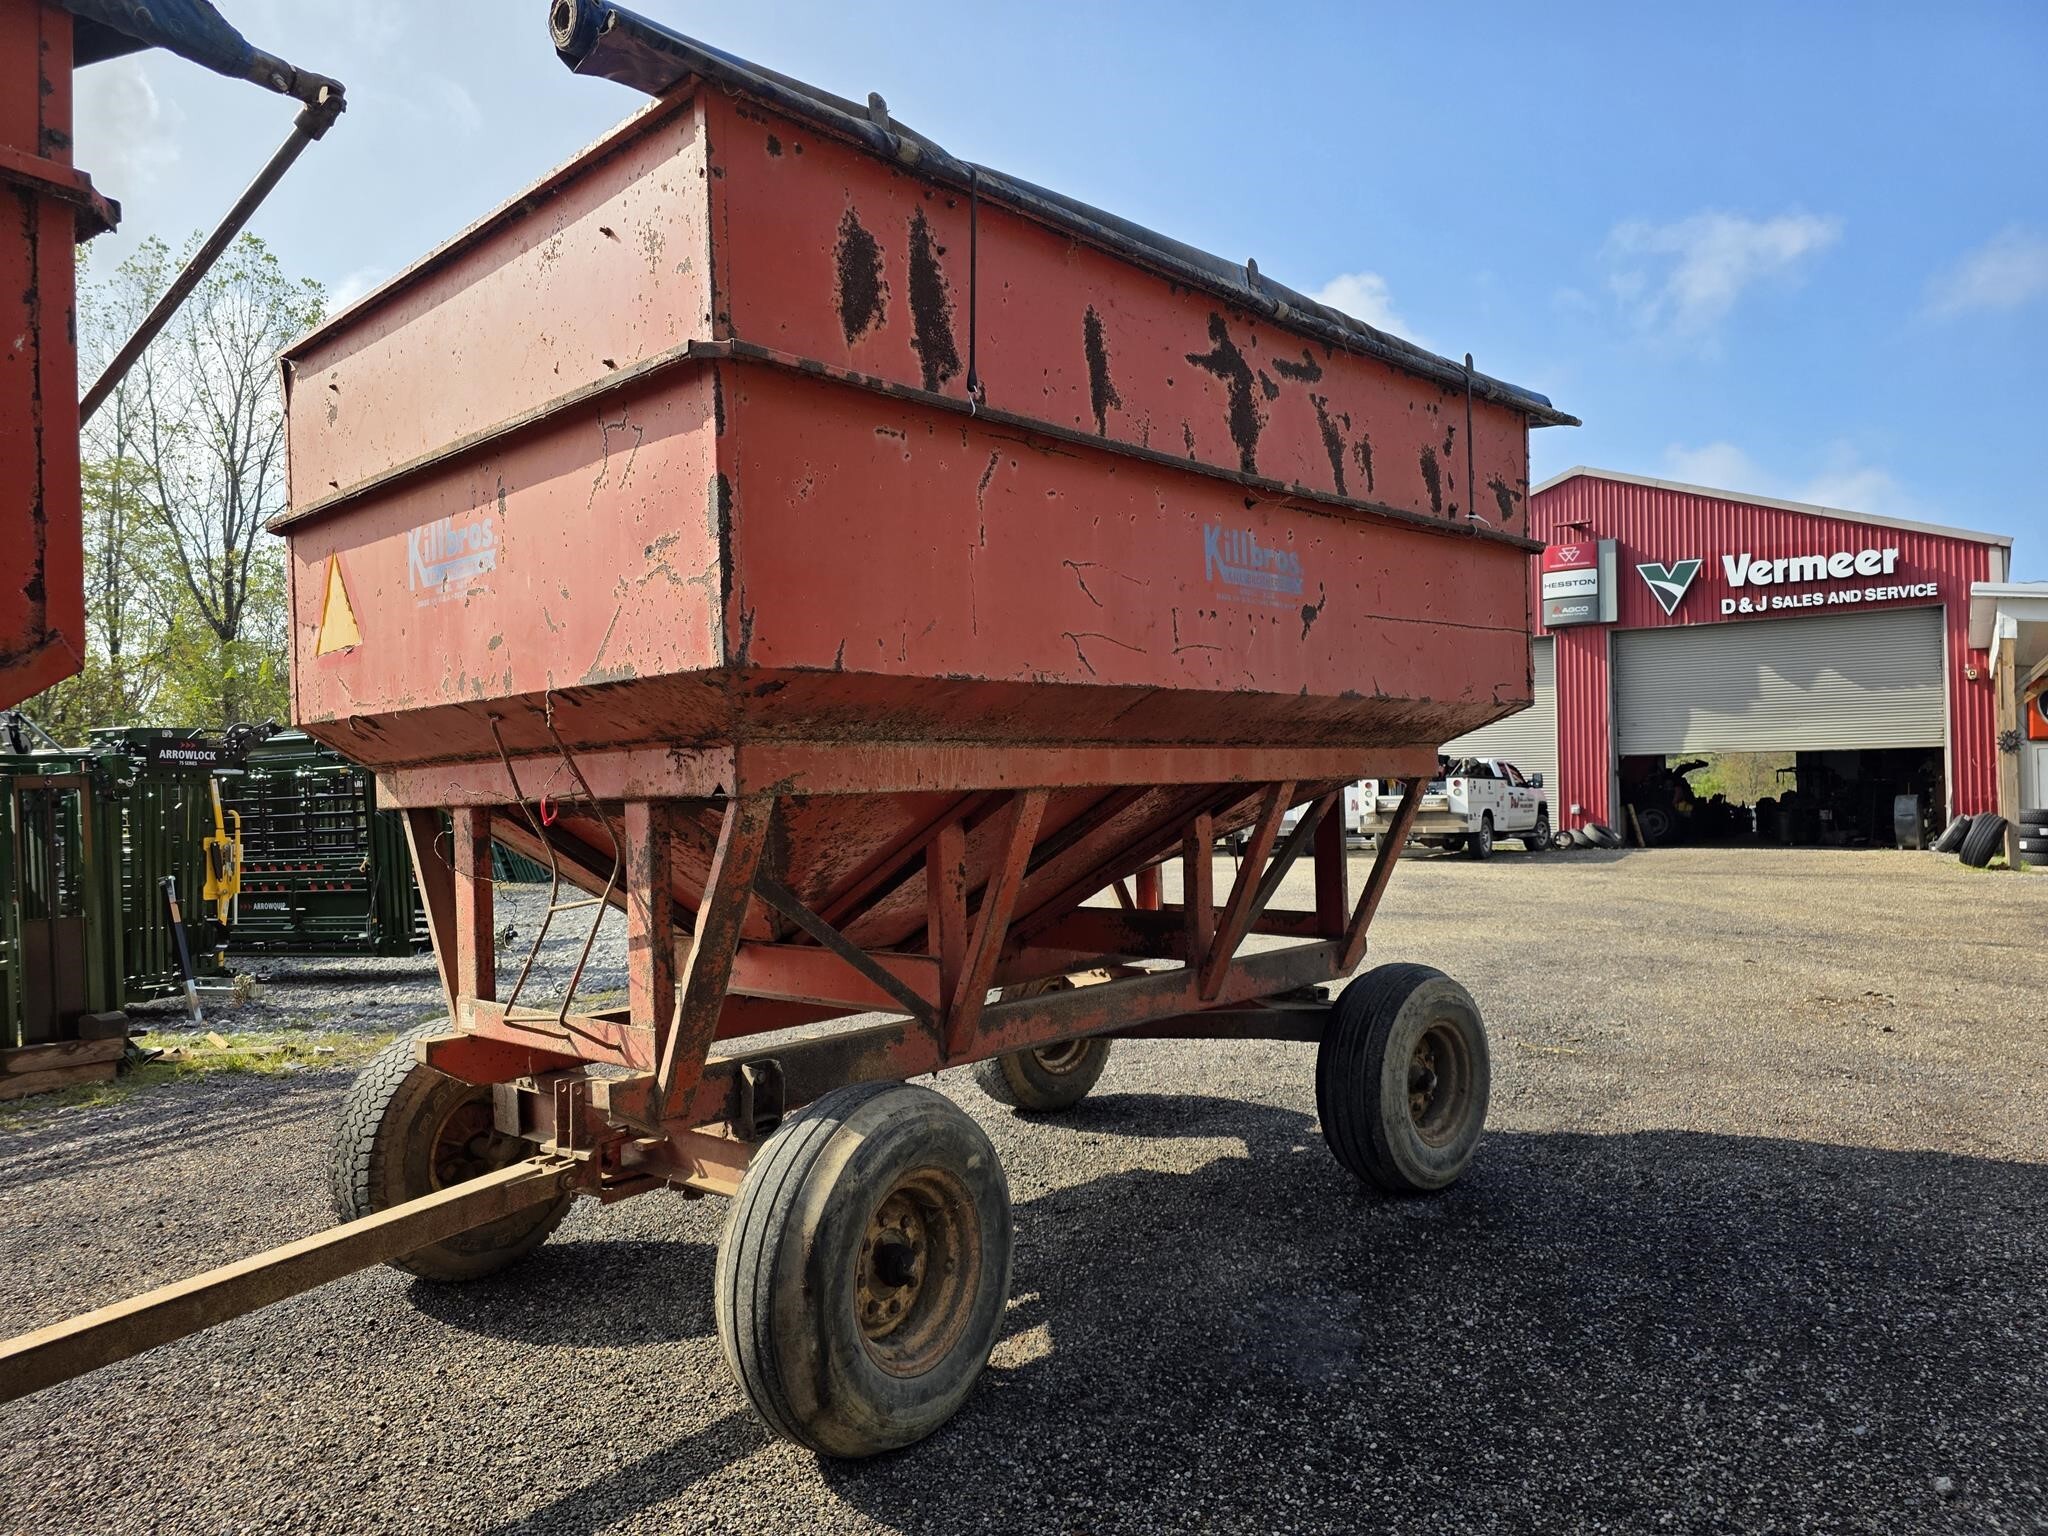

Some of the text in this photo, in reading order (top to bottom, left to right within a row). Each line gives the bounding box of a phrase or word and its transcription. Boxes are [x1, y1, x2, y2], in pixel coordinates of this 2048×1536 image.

[1722, 548, 1899, 587] Vermeer
[1544, 579, 1596, 589] HESSTON
[1721, 583, 1938, 615] D & J SALES AND SERVICE
[159, 750, 216, 760] ARROWLOCK
